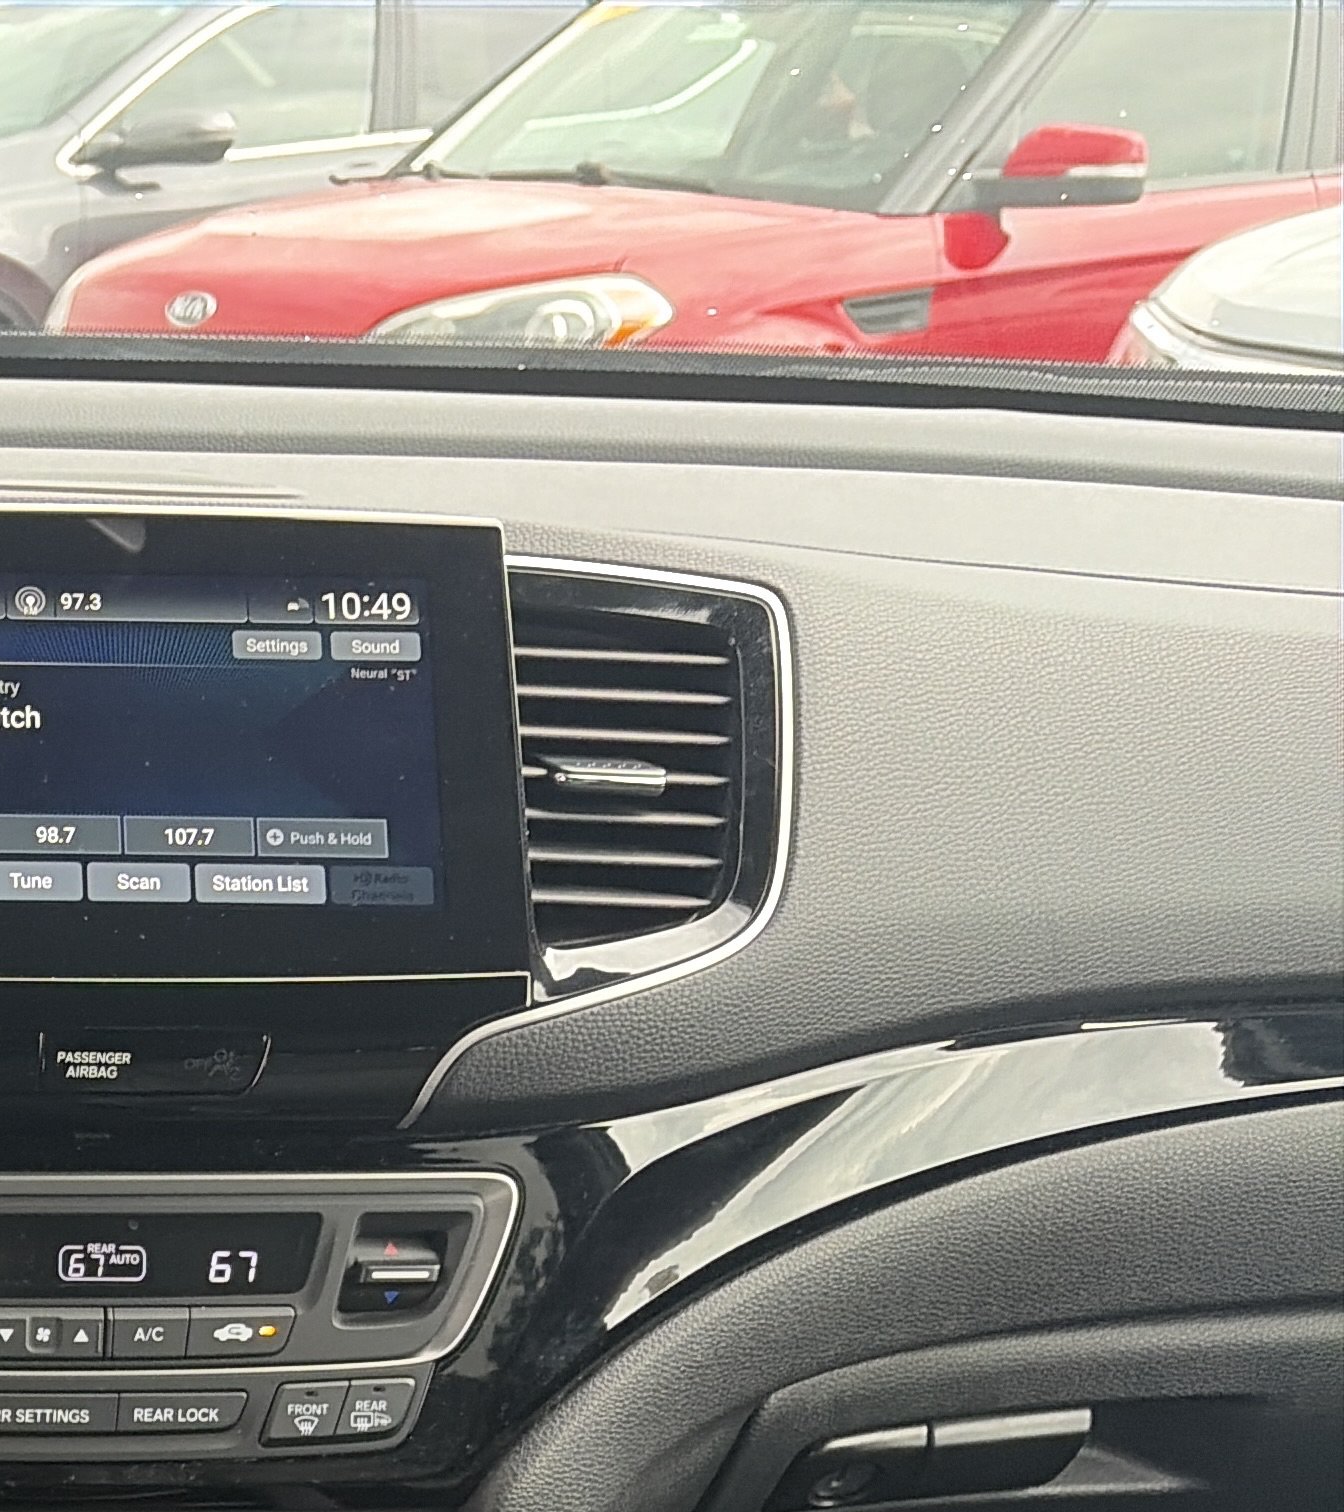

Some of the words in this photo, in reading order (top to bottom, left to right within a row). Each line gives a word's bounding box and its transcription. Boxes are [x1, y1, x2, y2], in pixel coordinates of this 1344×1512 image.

[60, 593, 102, 611] 97.3
[320, 592, 412, 621] 10:49
[246, 638, 309, 656] Settings
[351, 639, 401, 655] Sound
[35, 826, 76, 844] 98.7
[164, 828, 214, 847] 107.7
[290, 831, 324, 846] Push
[327, 832, 338, 846] &
[341, 832, 372, 846] Hold
[9, 872, 53, 890] Tune
[116, 874, 161, 891] Scan
[212, 874, 274, 892] Station
[277, 876, 309, 893] List
[56, 1050, 132, 1065] PASSENGER
[65, 1065, 118, 1080] AIRBAG
[86, 1243, 116, 1255] REAR
[67, 1254, 105, 1278] 67
[109, 1253, 140, 1266] AUTO
[208, 1250, 259, 1283] 67
[132, 1325, 165, 1343] A/C
[287, 1403, 330, 1416] FRONT
[355, 1400, 388, 1412] REAR
[15, 1409, 90, 1424] SETTINGS
[133, 1407, 174, 1423] REAR
[177, 1408, 220, 1422] LOCK
